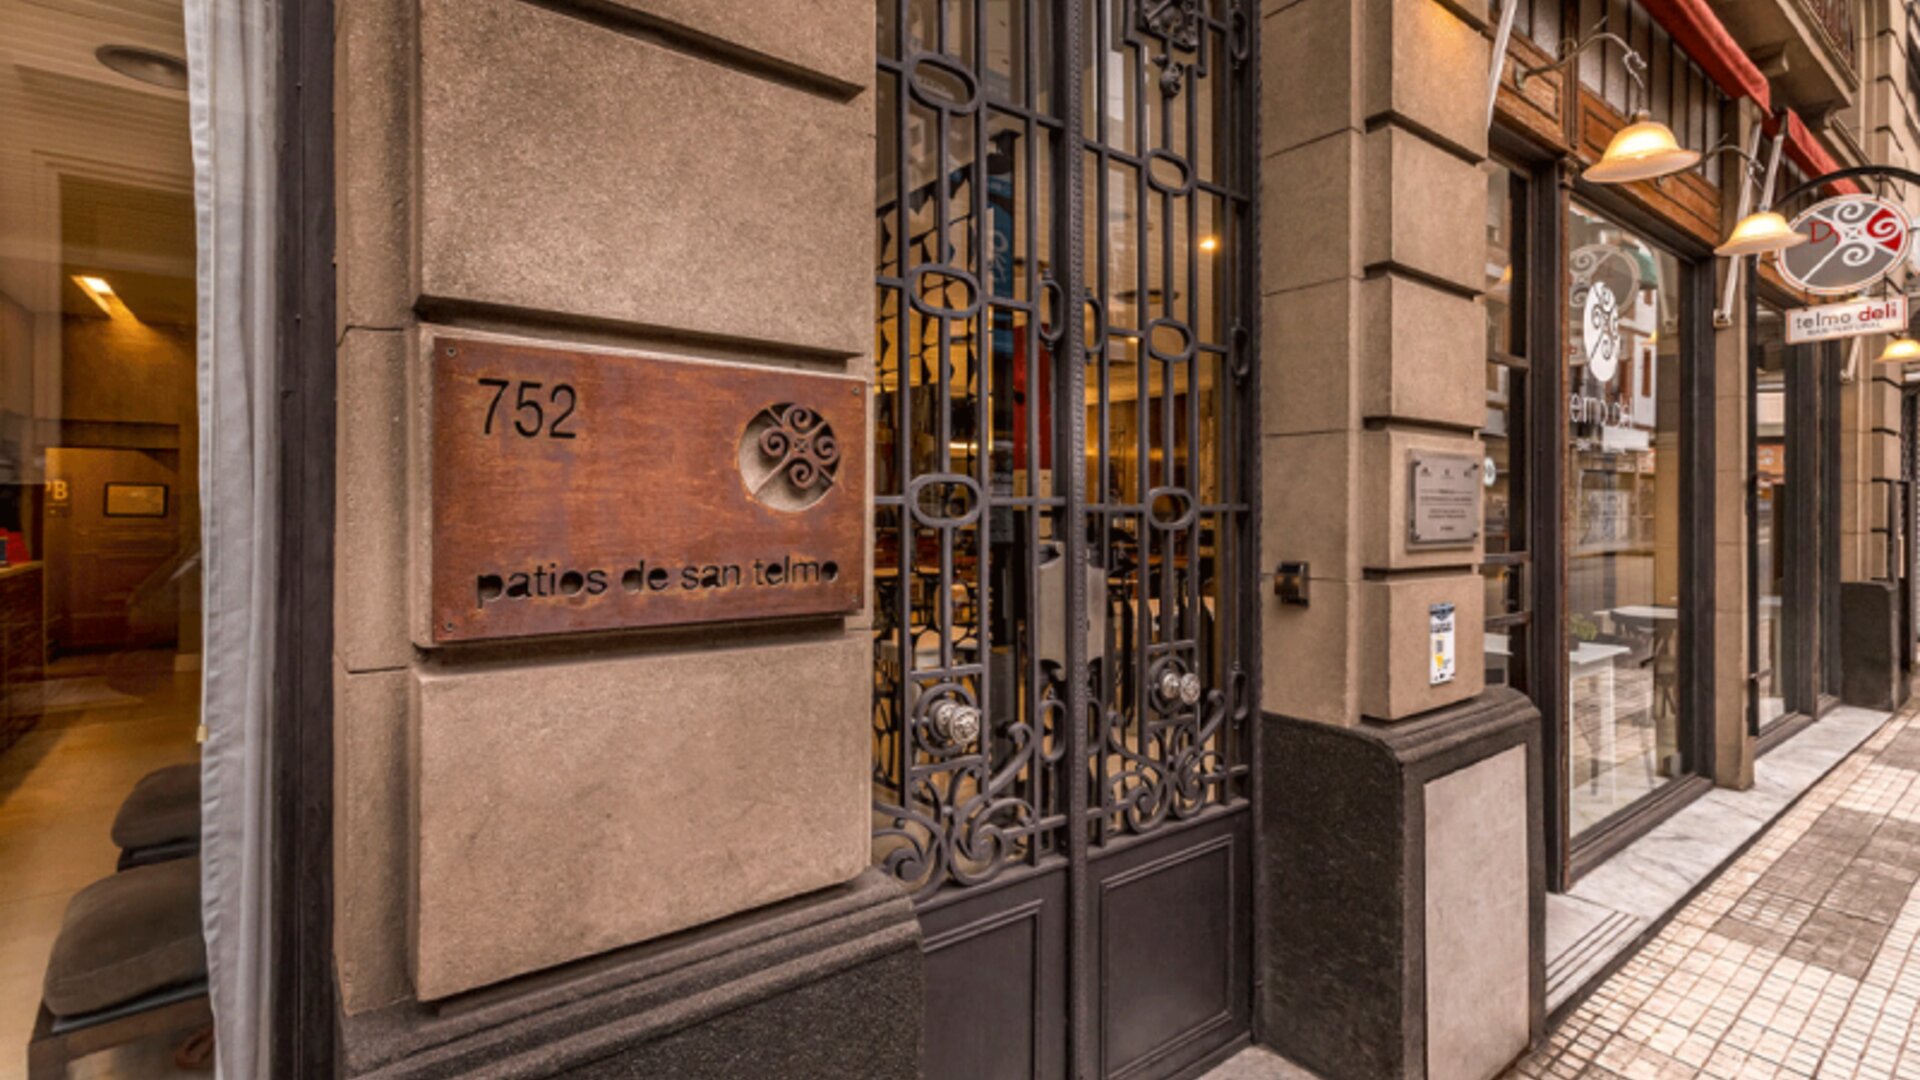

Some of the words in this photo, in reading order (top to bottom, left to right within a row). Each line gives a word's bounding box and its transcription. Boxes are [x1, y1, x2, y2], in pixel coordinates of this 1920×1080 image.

[1796, 311, 1852, 330] telmo
[1858, 302, 1897, 322] deli
[477, 377, 578, 439] 752
[476, 562, 608, 609] patios
[621, 559, 669, 595] de
[680, 563, 742, 591] san
[753, 554, 840, 587] telmo
